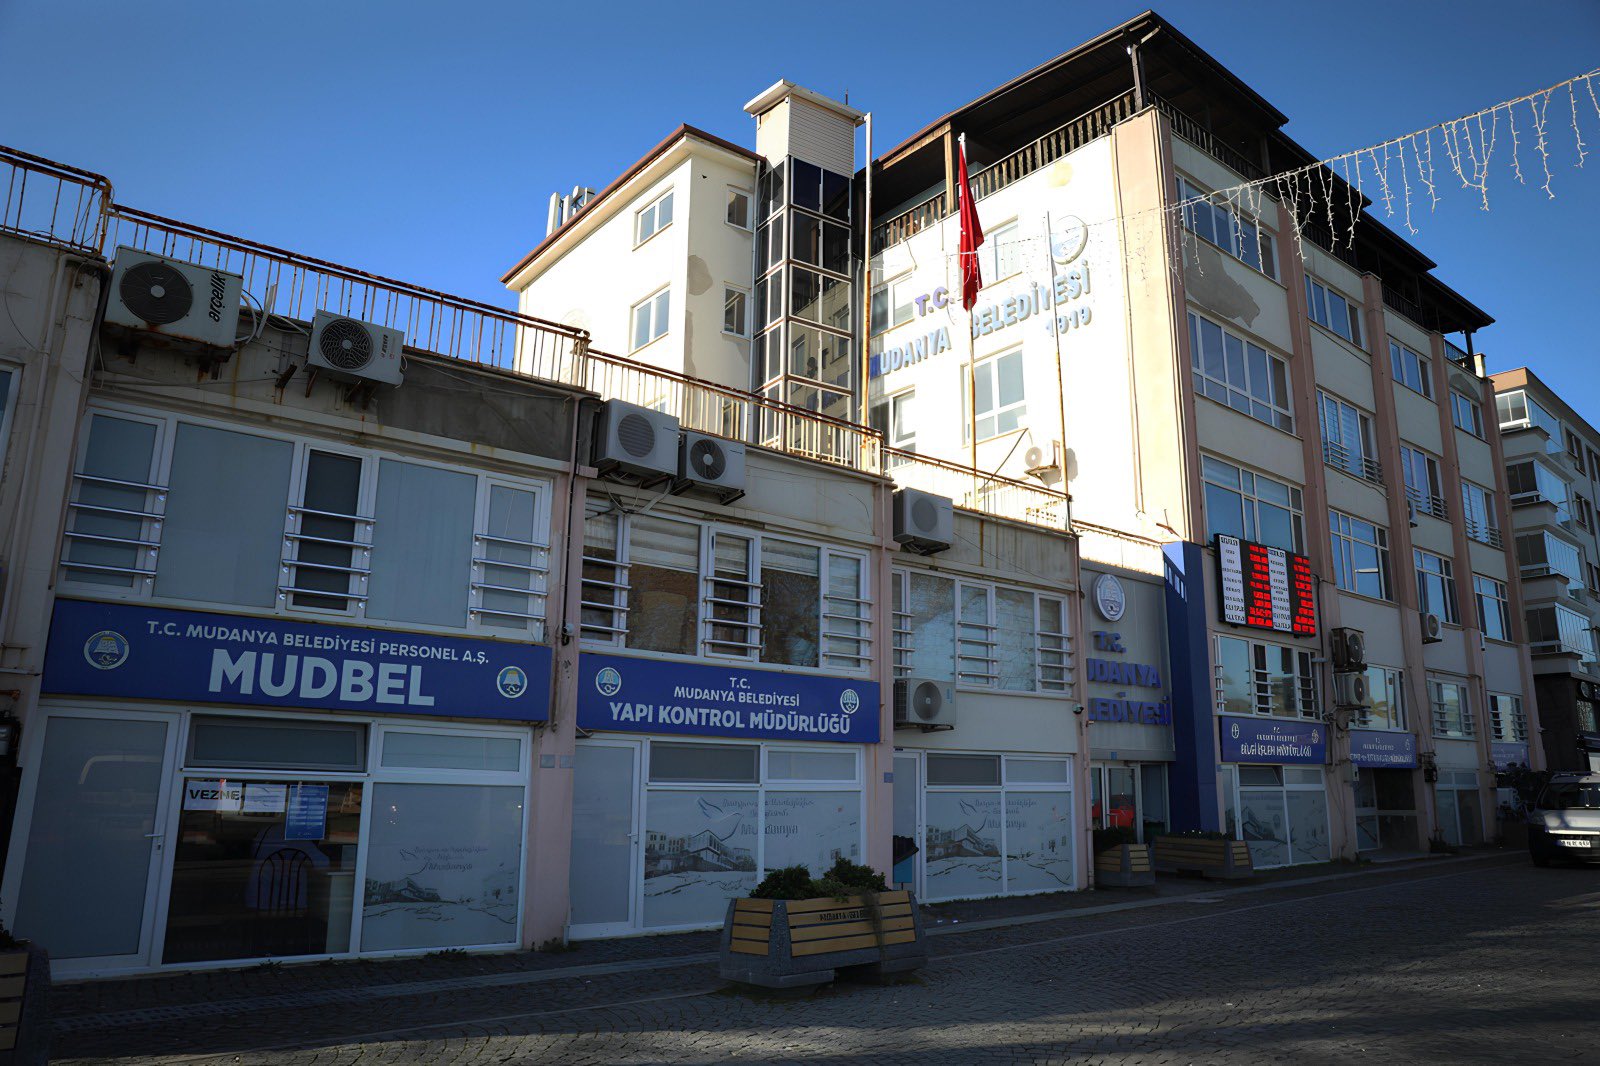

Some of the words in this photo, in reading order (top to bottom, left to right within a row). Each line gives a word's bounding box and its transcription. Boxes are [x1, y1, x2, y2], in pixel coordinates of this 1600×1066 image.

[209, 272, 226, 322] arçelik
[915, 286, 955, 317] T.C.
[147, 620, 181, 637] T.C.
[186, 624, 278, 645] MUDANYA
[283, 633, 376, 654] BELEDİYESİ
[379, 643, 459, 661] PERSONEL
[462, 650, 490, 665] A.Ş.
[208, 648, 436, 707] MUDBEL
[729, 677, 751, 690] T.C.
[673, 686, 736, 702] MUDANYA
[738, 692, 800, 707] BELEDİYESİ
[609, 702, 654, 723] YAPI
[658, 706, 746, 729] KONTROL
[749, 710, 851, 734] MÜDÜRLÜĞÜ
[189, 789, 240, 801] VEZNE
